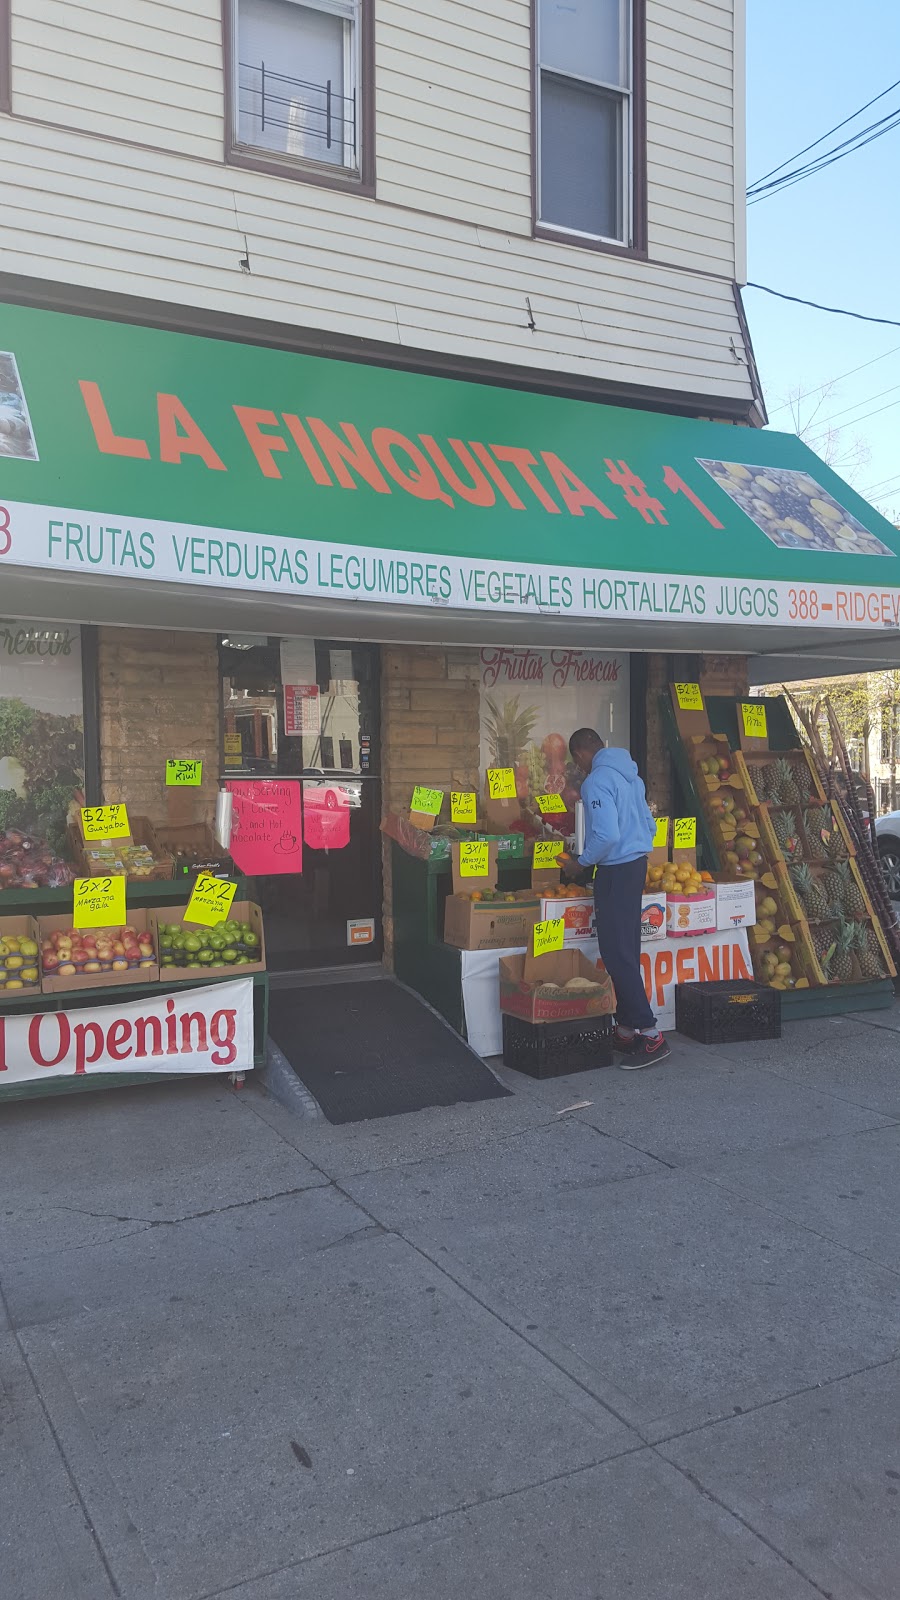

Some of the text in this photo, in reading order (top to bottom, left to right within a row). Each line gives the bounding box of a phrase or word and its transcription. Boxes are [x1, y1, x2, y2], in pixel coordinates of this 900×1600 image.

[78, 380, 228, 472] LA
[232, 404, 618, 521] FINQUITA
[48, 520, 156, 571] FRUTAS
[171, 534, 309, 586] VERDURAS
[317, 552, 452, 598] LEGUMBRES
[459, 568, 574, 608] VEGETALES
[582, 577, 706, 615] HORTALIZAS
[715, 585, 779, 618] JUGOS
[480, 647, 622, 688] Frutas Frescas
[175, 772, 197, 781] Kiwi
[252, 781, 292, 806] Serving
[590, 799, 602, 810] 24
[86, 822, 126, 834] Guayaba
[28, 999, 238, 1075] Opening
